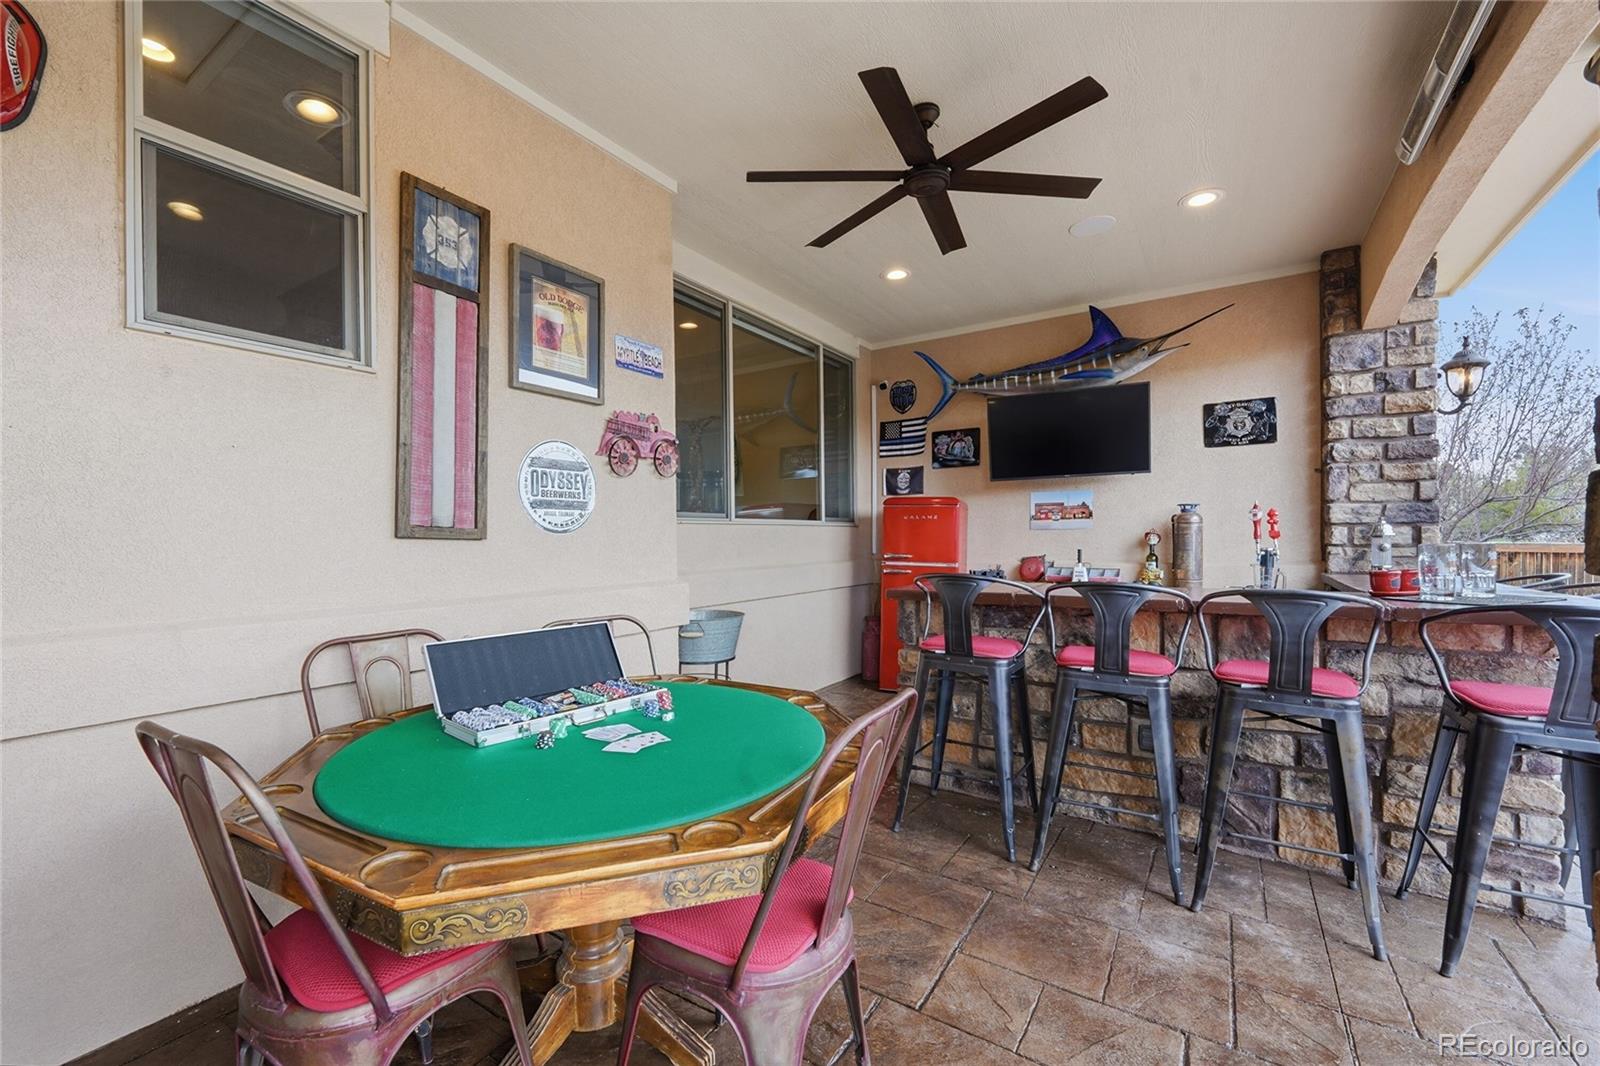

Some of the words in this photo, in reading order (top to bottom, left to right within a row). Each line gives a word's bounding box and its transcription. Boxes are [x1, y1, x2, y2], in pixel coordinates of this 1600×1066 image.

[538, 292, 556, 302] OLD
[530, 468, 588, 500] ODYSSEY
[540, 489, 582, 500] BEERWERKS
